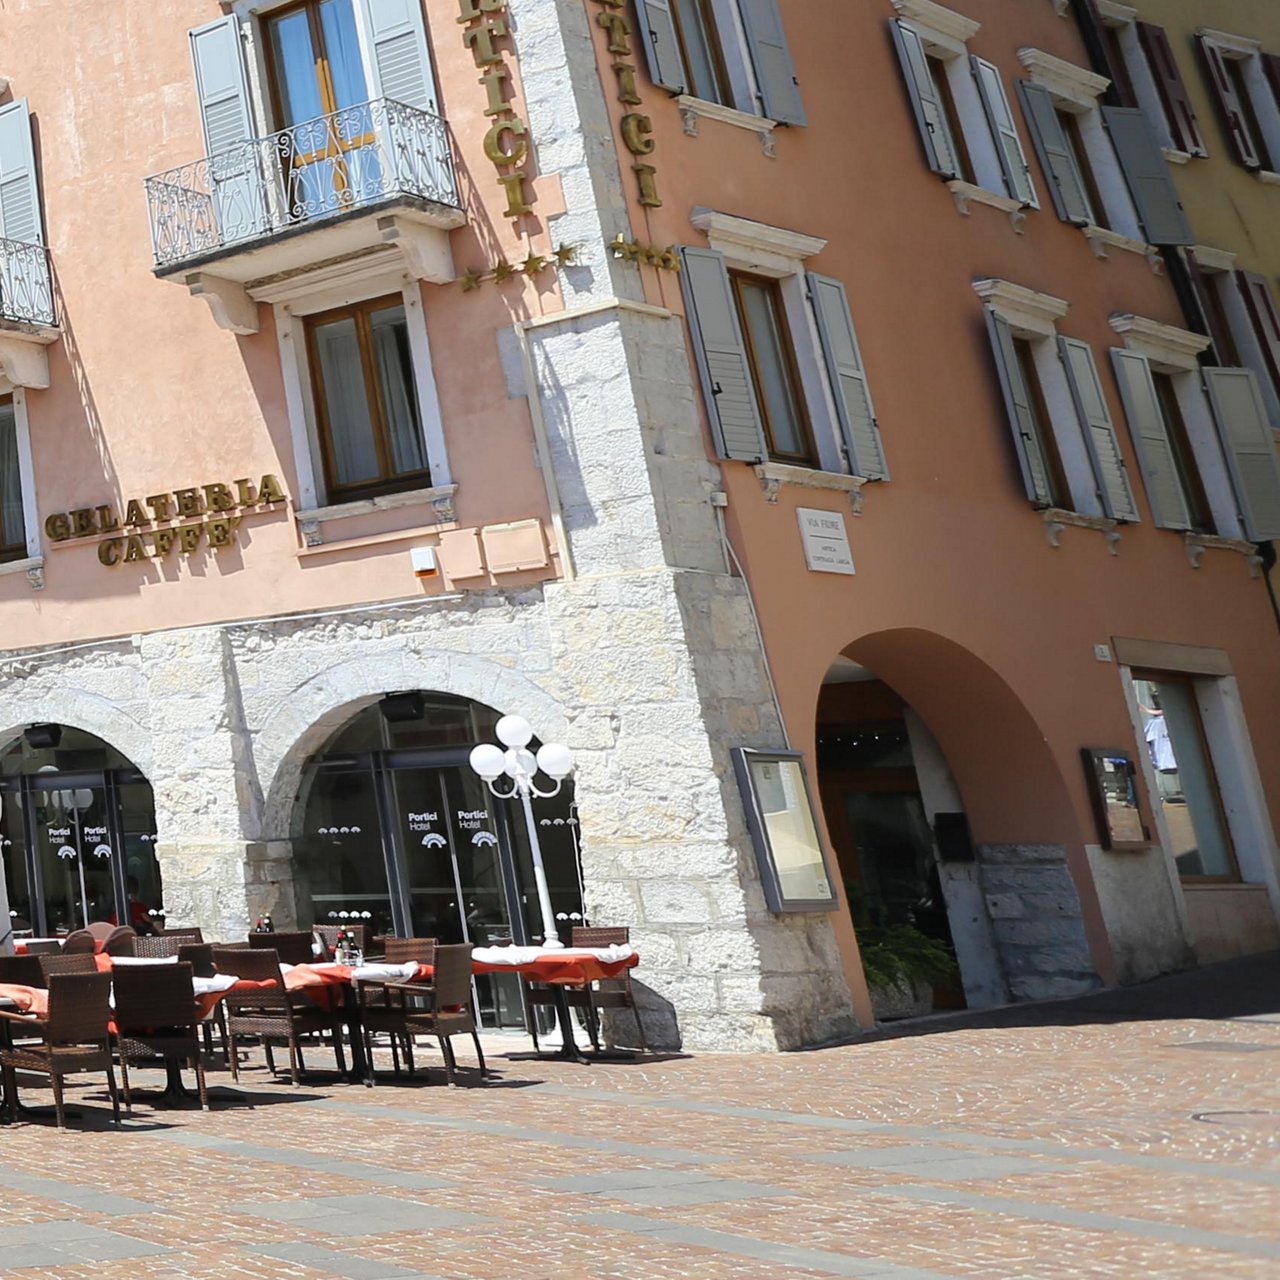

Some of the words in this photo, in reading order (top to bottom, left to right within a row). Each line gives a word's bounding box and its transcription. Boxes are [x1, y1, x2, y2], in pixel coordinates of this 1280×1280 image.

[45, 474, 287, 540] GELATERIA
[408, 812, 438, 822] Portici
[458, 810, 488, 820] Portici
[409, 821, 431, 831] Hotel
[459, 820, 481, 829] Hotel
